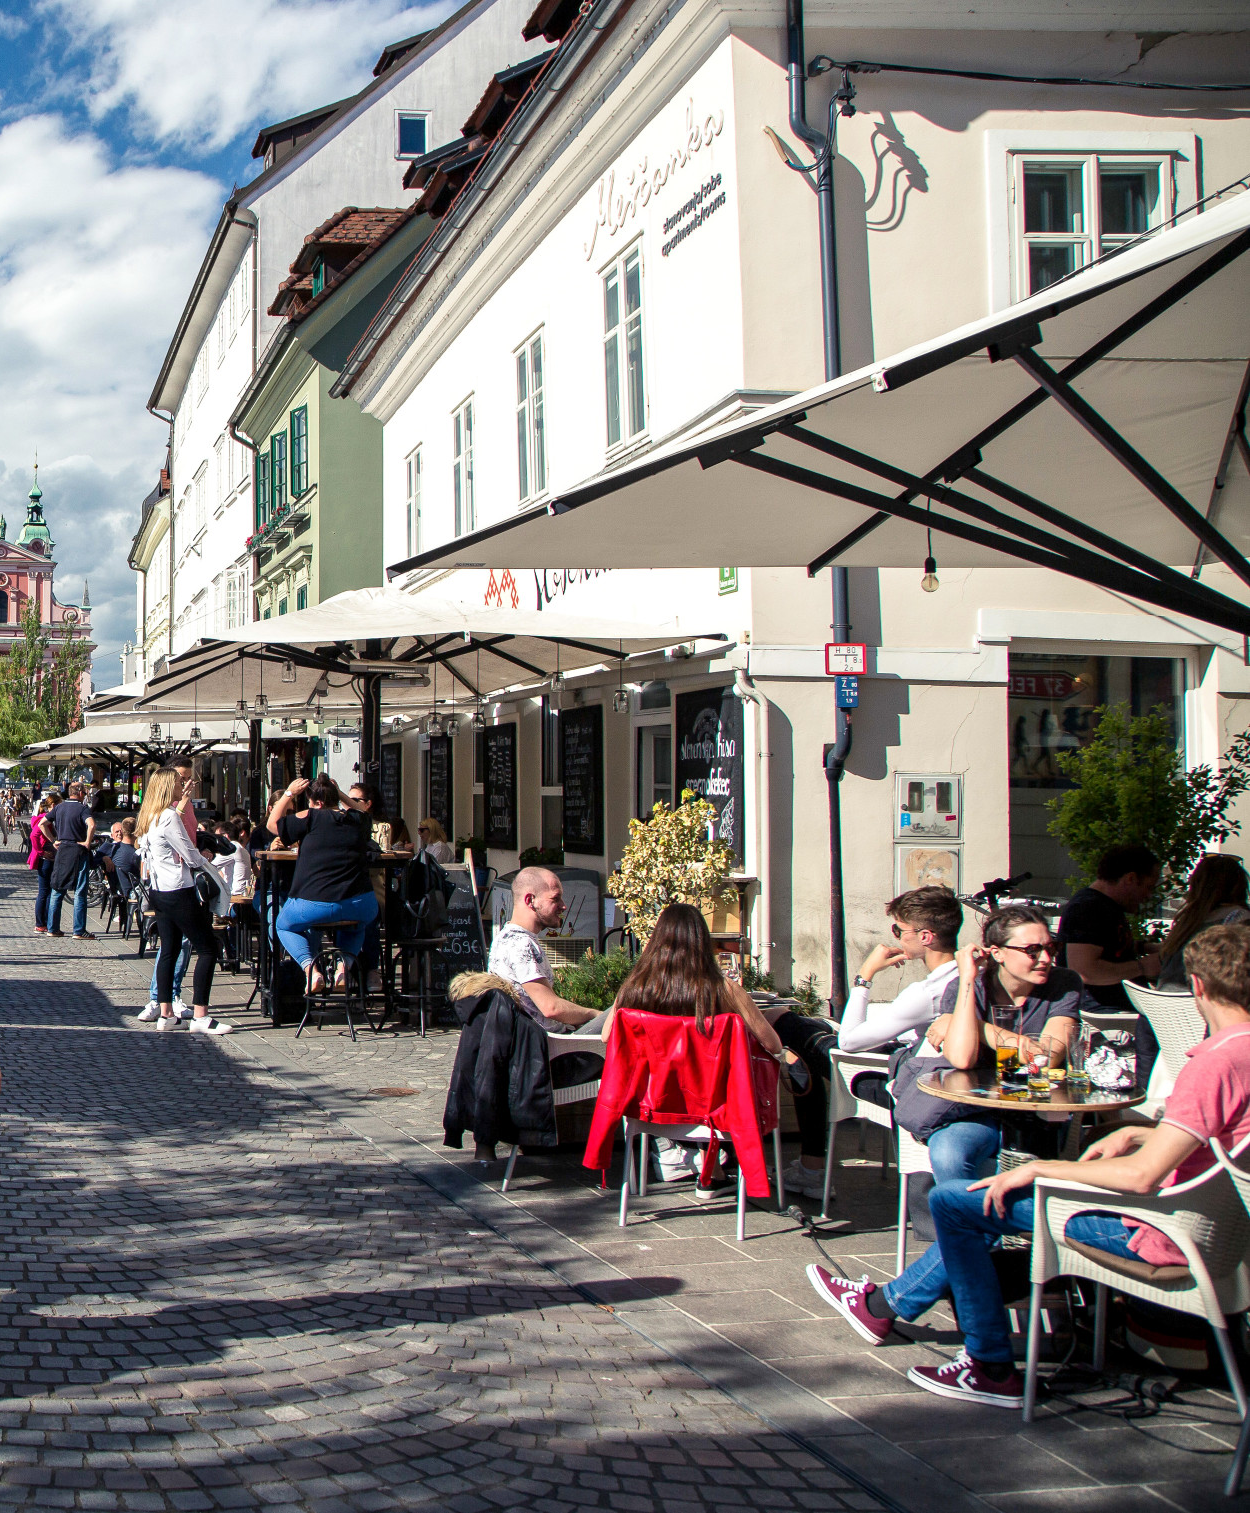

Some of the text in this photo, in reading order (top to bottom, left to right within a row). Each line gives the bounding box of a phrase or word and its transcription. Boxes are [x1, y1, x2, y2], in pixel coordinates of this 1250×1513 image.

[583, 96, 725, 262] Meščanka
[662, 172, 722, 236] stanovanja/sobe
[661, 191, 726, 257] apartments/rooms
[835, 646, 856, 654] H 80
[841, 680, 847, 688] Z
